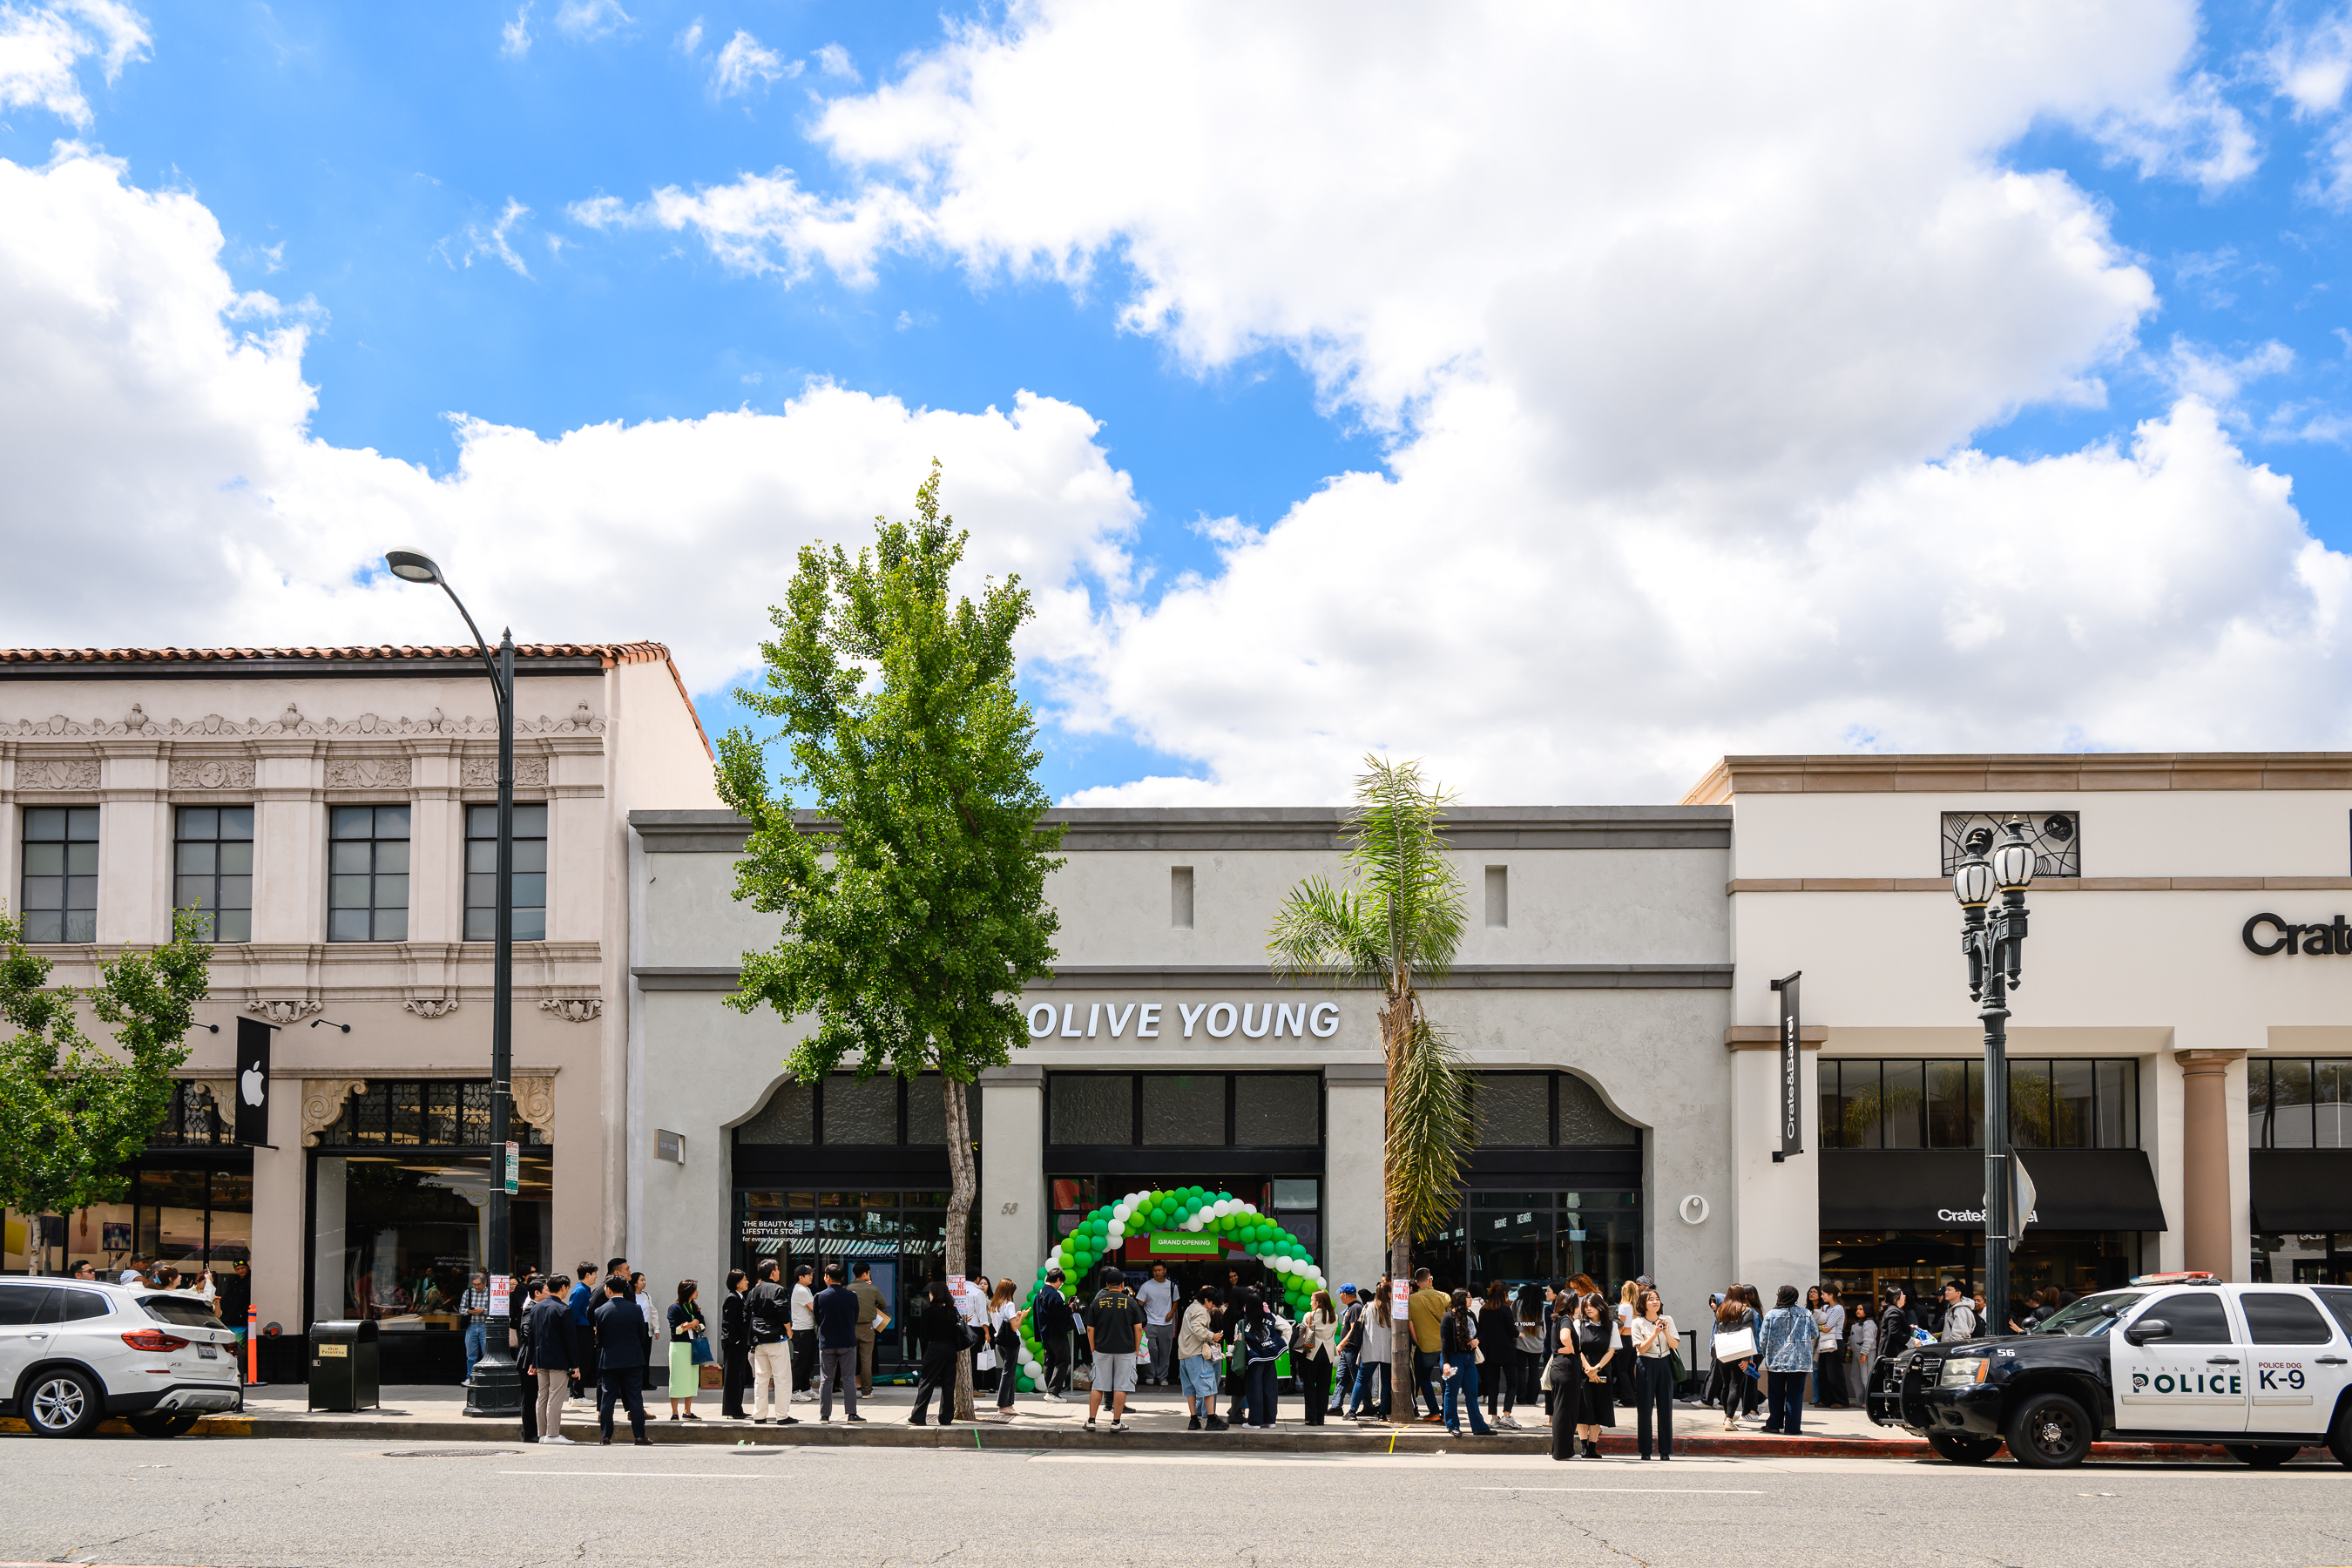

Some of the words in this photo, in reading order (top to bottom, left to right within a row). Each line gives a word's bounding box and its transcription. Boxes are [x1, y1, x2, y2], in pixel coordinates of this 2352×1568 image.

[2242, 912, 2352, 956] Crat
[1026, 1003, 1163, 1039] OLIVE
[1178, 1002, 1341, 1038] YOUNG
[1786, 1015, 1795, 1140] Crate&Barrel
[1001, 1202, 1018, 1215] 58
[1997, 1348, 2016, 1357] 56
[2132, 1373, 2241, 1394] POLICE
[2259, 1369, 2306, 1390] K-9
